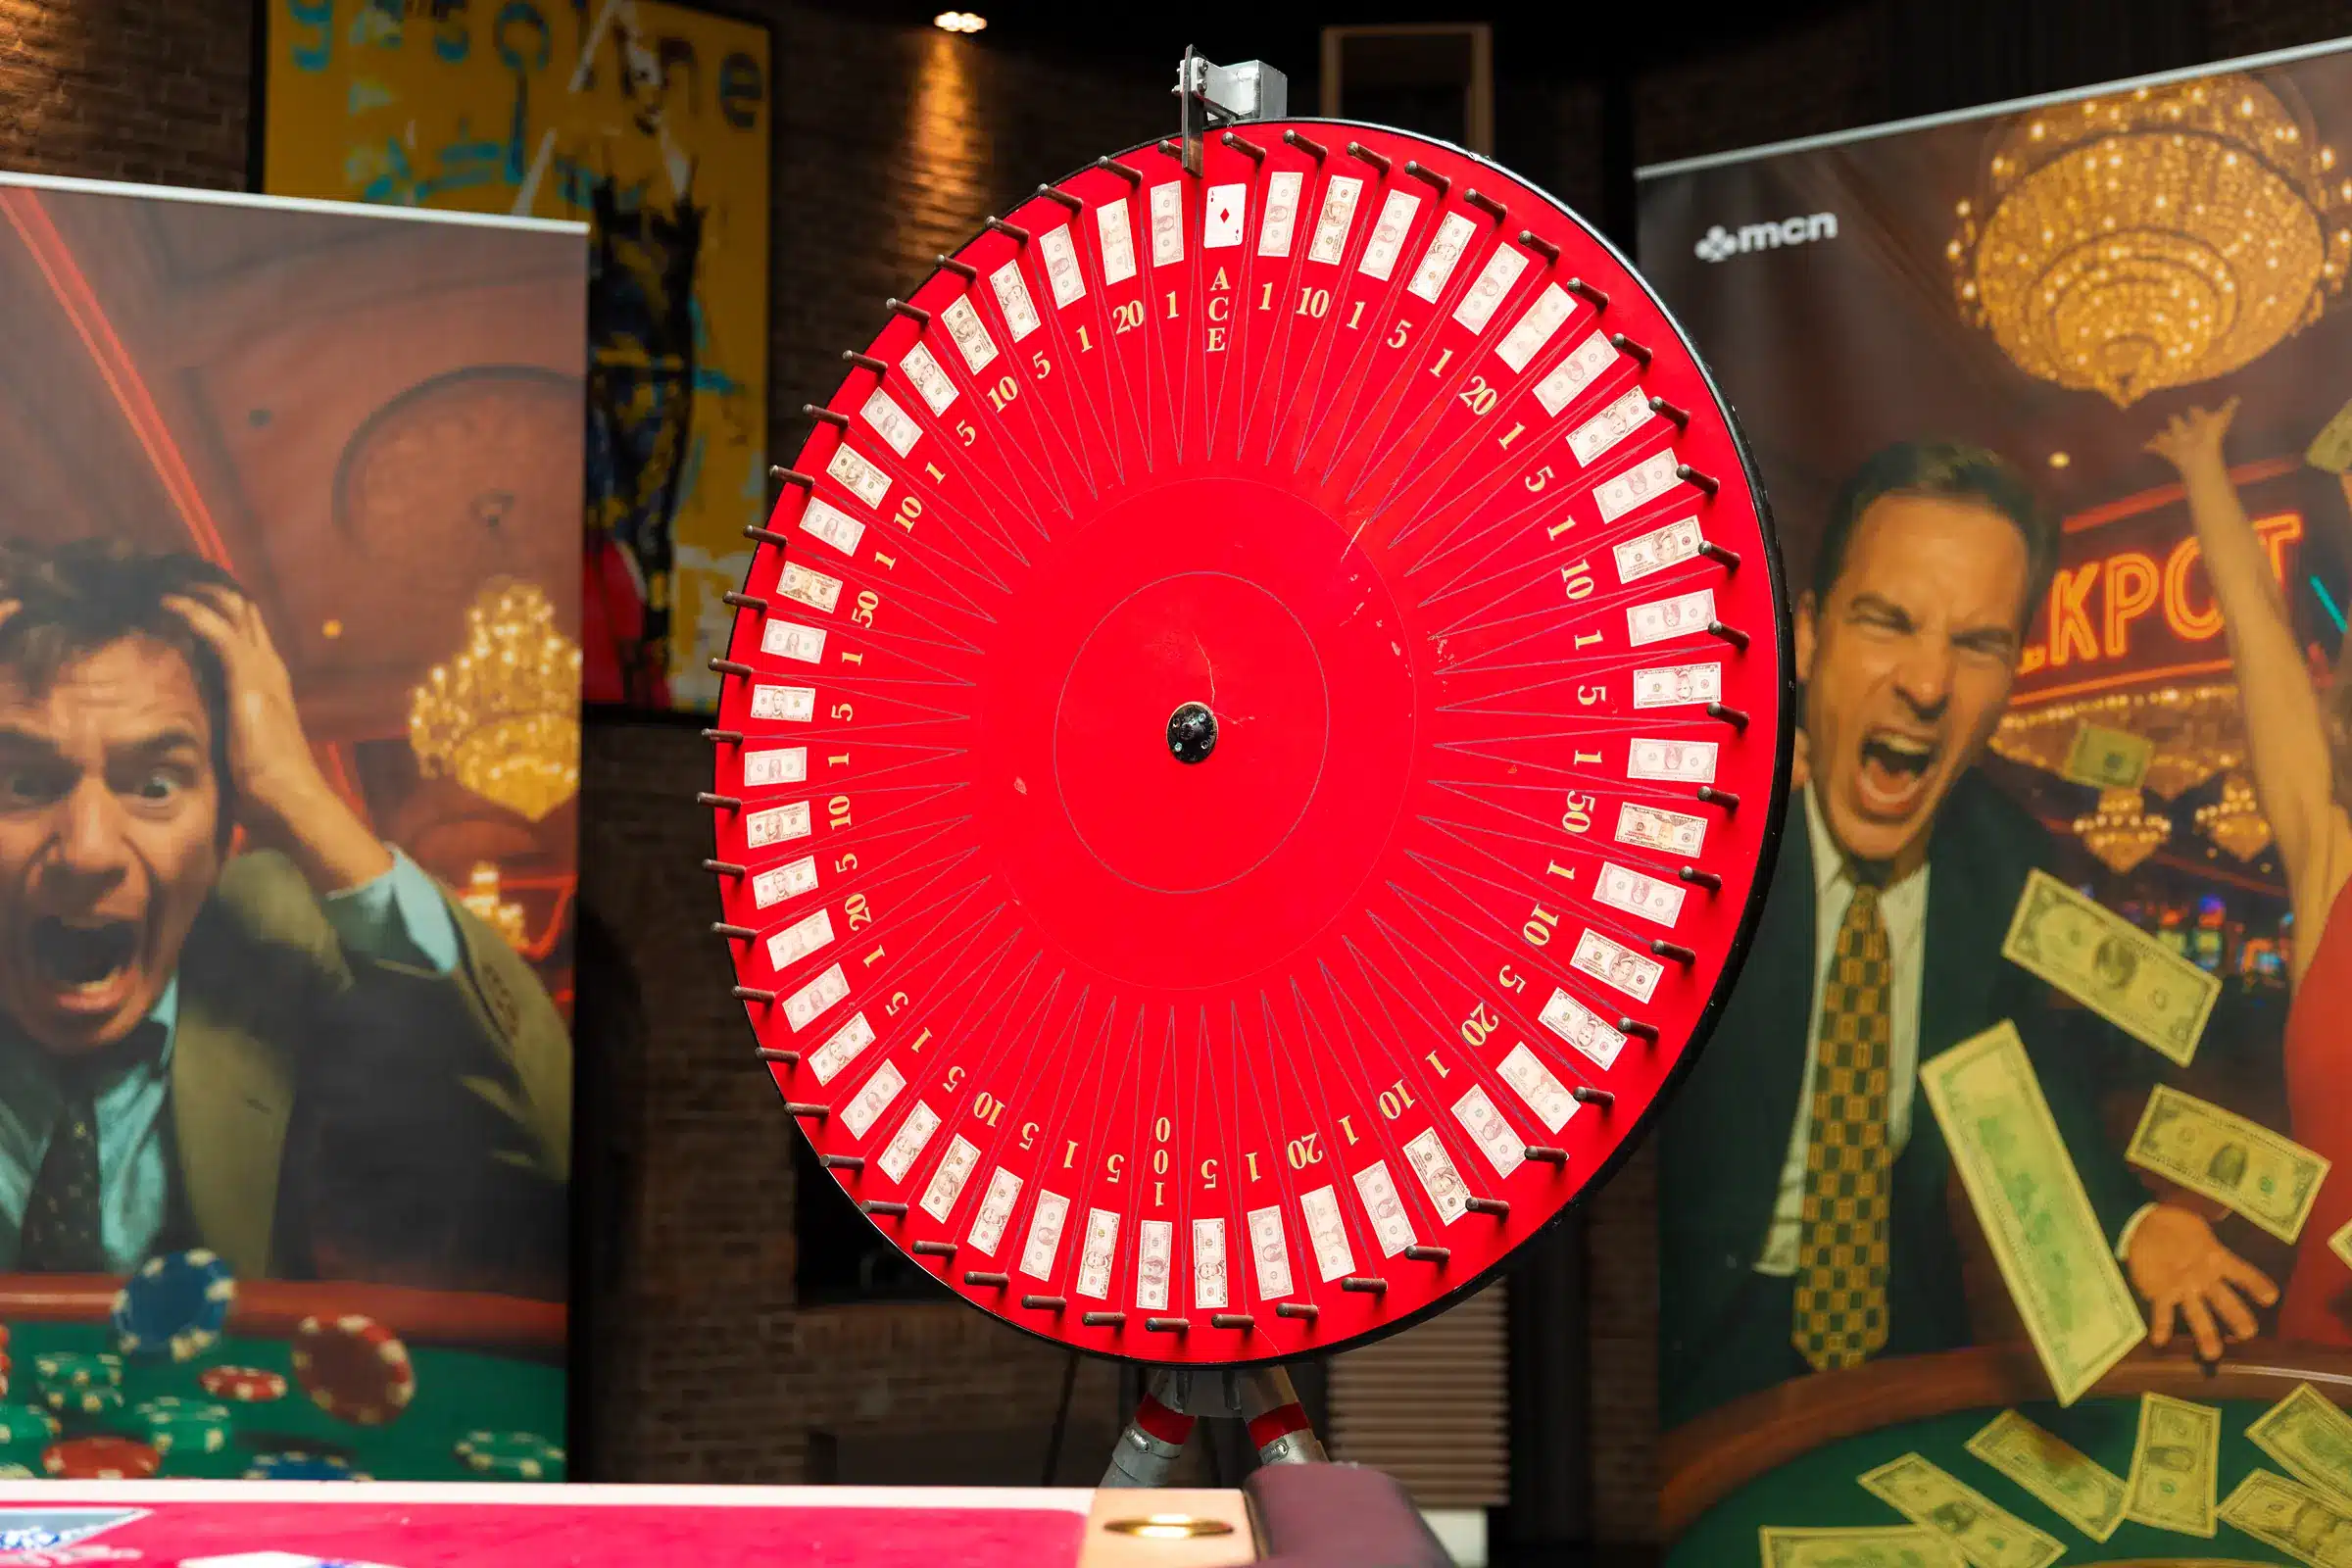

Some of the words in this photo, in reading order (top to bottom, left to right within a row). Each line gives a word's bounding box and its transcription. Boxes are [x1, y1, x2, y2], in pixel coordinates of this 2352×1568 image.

[1738, 212, 1838, 254] mcn
[1165, 290, 1180, 319] 1
[1205, 266, 1231, 353] ACE
[1258, 281, 1273, 311] 1
[1295, 286, 1330, 318] 10
[1112, 299, 1145, 334] 20
[1346, 301, 1366, 330] 1
[1076, 324, 1094, 353] 1
[1387, 318, 1412, 349] 5
[1032, 350, 1052, 379] 5
[1429, 348, 1453, 377] 1
[987, 375, 1018, 414] 10
[1458, 375, 1497, 416] 20
[956, 418, 976, 447] 5
[1497, 421, 1526, 451] 1
[924, 462, 946, 484] 1
[1524, 466, 1554, 492] 5
[893, 496, 922, 533] 10
[1546, 514, 1576, 542] 1
[874, 551, 897, 570] 1
[1560, 559, 1594, 600] 10
[851, 590, 879, 629] 50
[1574, 629, 1604, 651] 1
[841, 652, 863, 666] 1
[1577, 685, 1606, 706] 5
[830, 703, 854, 722] 5
[827, 752, 850, 767] 1
[1573, 750, 1602, 765] 1
[828, 795, 852, 830] 10
[1561, 790, 1596, 833] 50
[835, 853, 858, 873] 5
[1546, 859, 1576, 880] 1
[844, 893, 872, 932] 20
[1523, 903, 1559, 947] 10
[862, 944, 886, 968] 1
[1498, 964, 1527, 994] 5
[885, 991, 909, 1016] 5
[1461, 1002, 1499, 1047] 20
[910, 1027, 933, 1054] 1
[942, 1065, 966, 1093] 5
[1425, 1050, 1450, 1079] 1
[973, 1092, 1005, 1128] 10
[1378, 1079, 1416, 1120] 10
[1018, 1122, 1040, 1151] 5
[1338, 1114, 1359, 1146] 1
[1063, 1140, 1079, 1169] 1
[1153, 1116, 1171, 1207] 100
[1287, 1132, 1323, 1170] 20
[1106, 1153, 1125, 1184] 5
[1200, 1158, 1218, 1190] 5
[1245, 1152, 1261, 1183] 1
